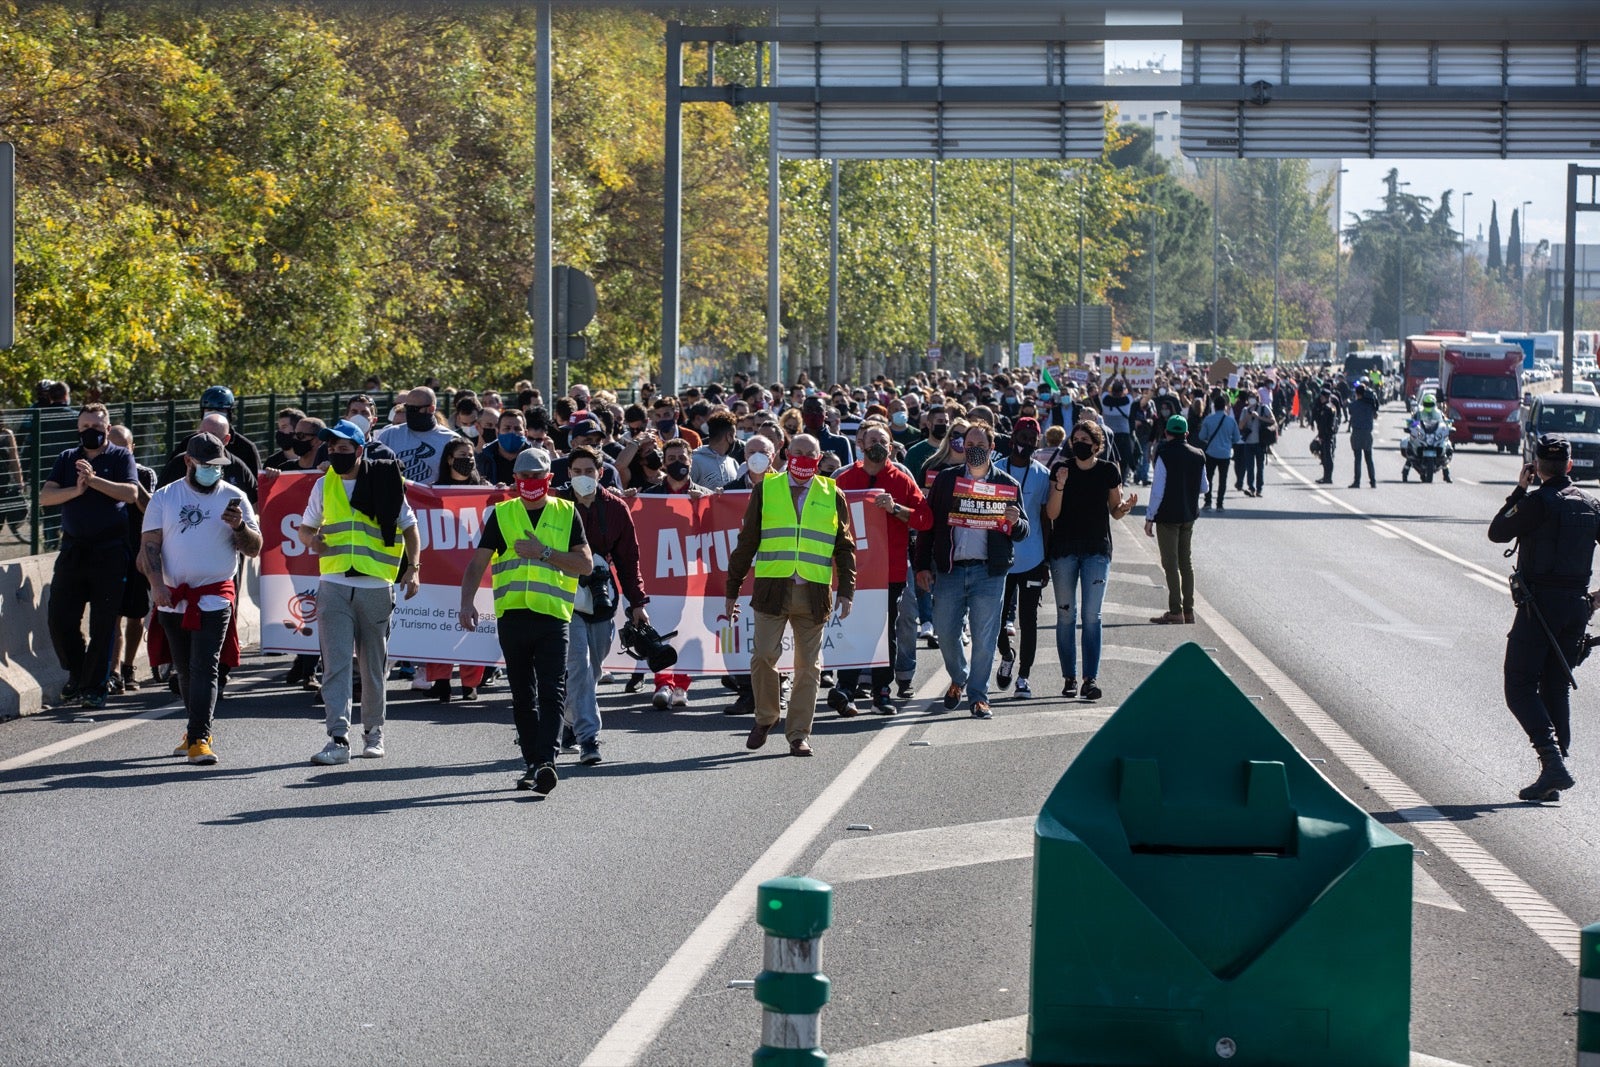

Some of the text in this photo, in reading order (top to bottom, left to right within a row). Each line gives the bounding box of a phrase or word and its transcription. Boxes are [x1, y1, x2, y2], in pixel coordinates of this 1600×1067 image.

[1105, 355, 1118, 364] NO
[976, 501, 985, 509] DE
[986, 502, 1007, 510] 5.000
[433, 608, 445, 618] de
[391, 619, 398, 629] y
[400, 619, 437, 631] Turismo
[440, 621, 452, 632] de
